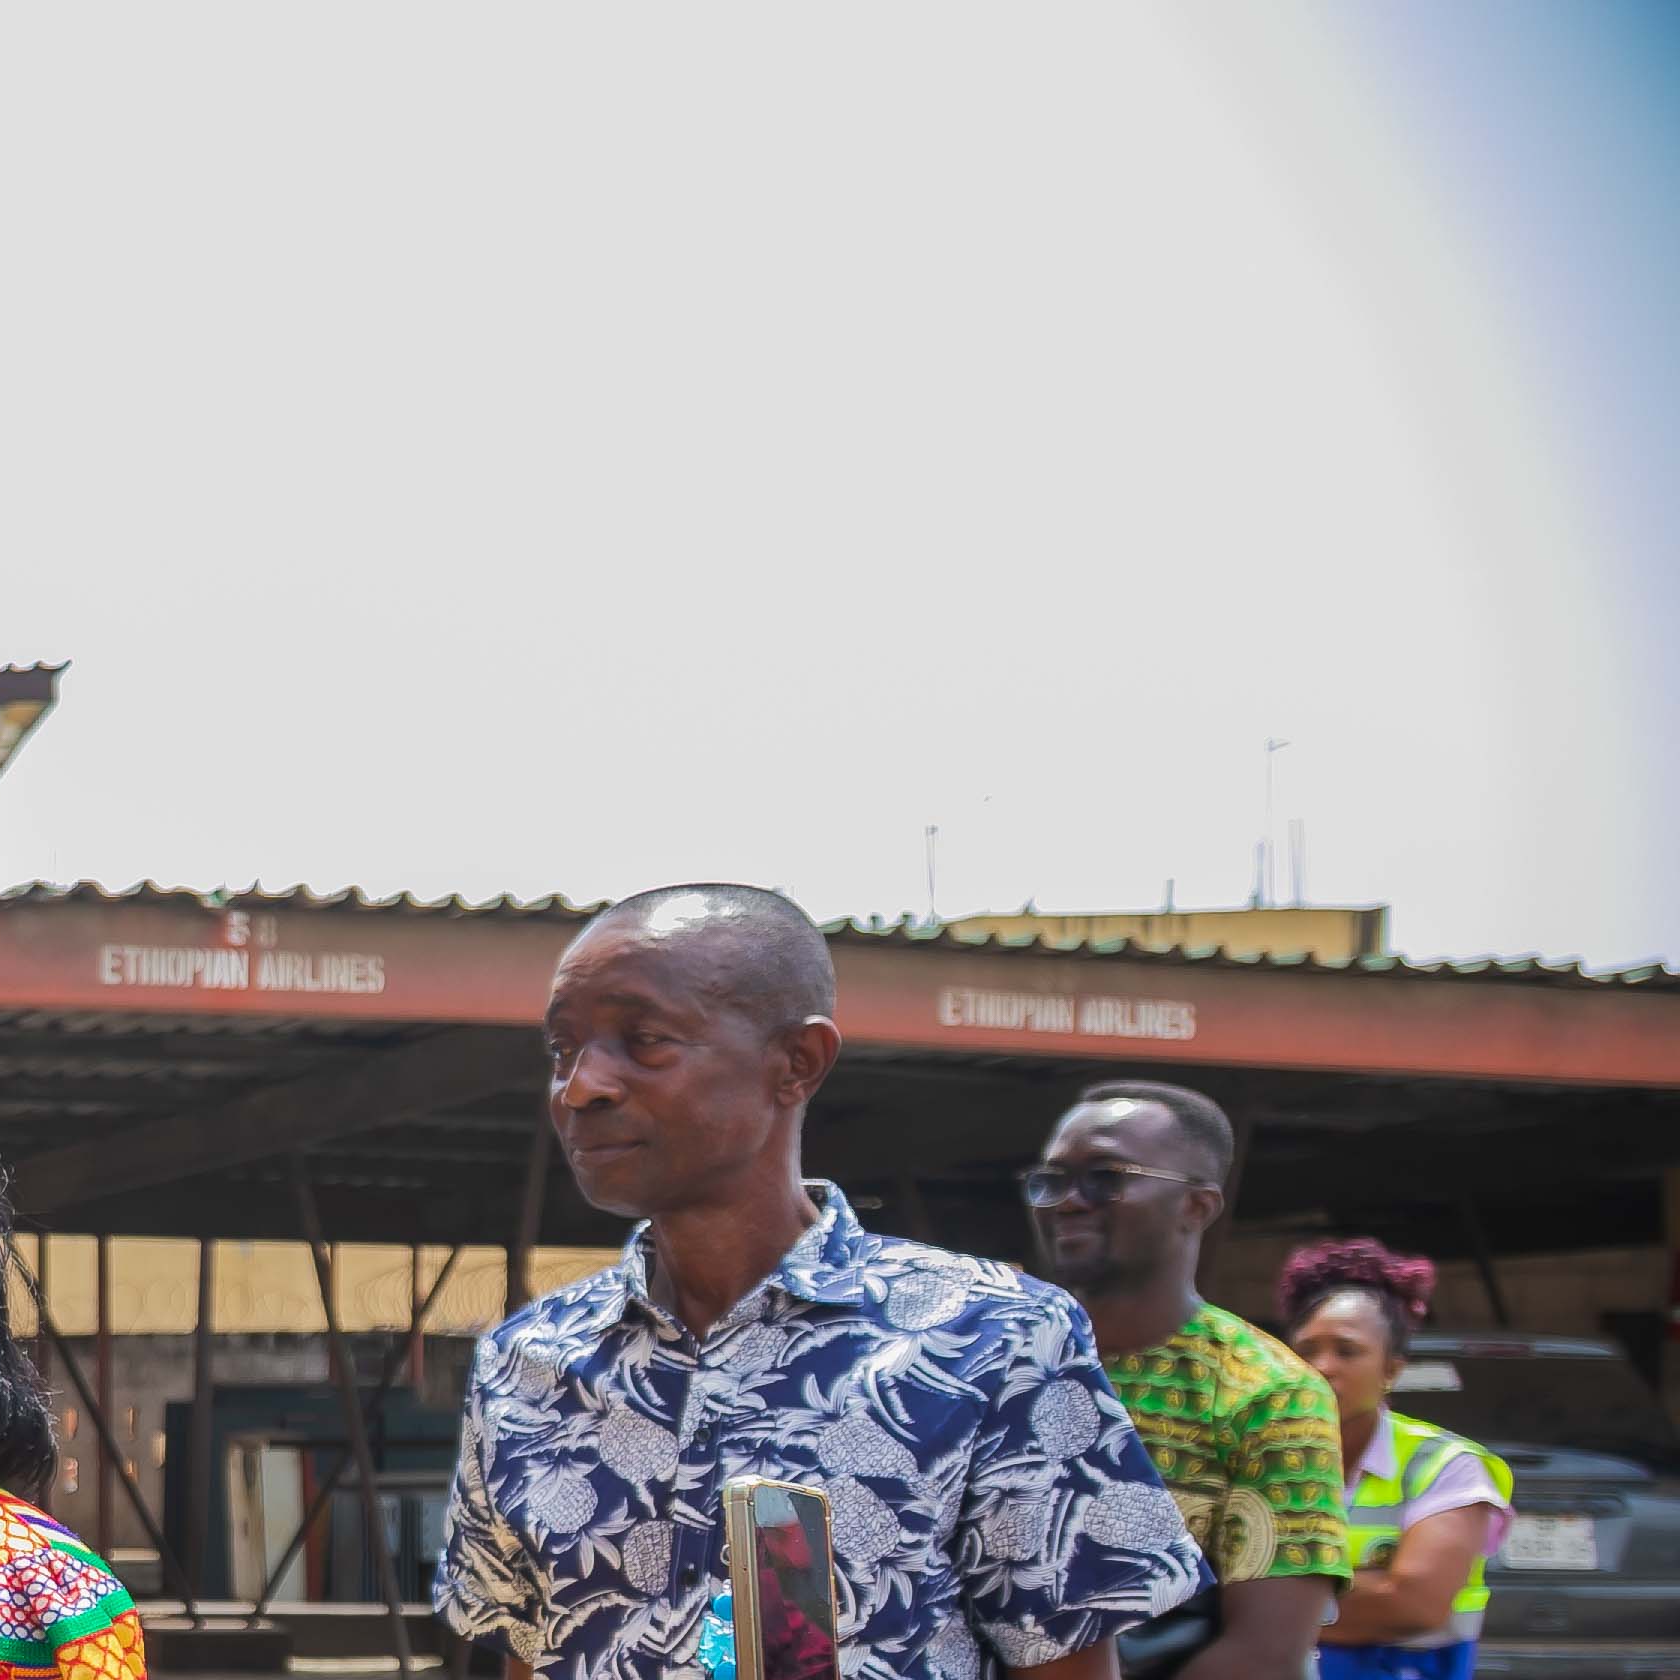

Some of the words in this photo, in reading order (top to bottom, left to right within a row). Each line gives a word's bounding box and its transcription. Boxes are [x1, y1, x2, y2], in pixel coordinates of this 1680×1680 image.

[100, 944, 250, 990] ETHIOPIAN
[256, 950, 385, 994] AIRLINES
[939, 986, 1074, 1033] ETHIOPIAN
